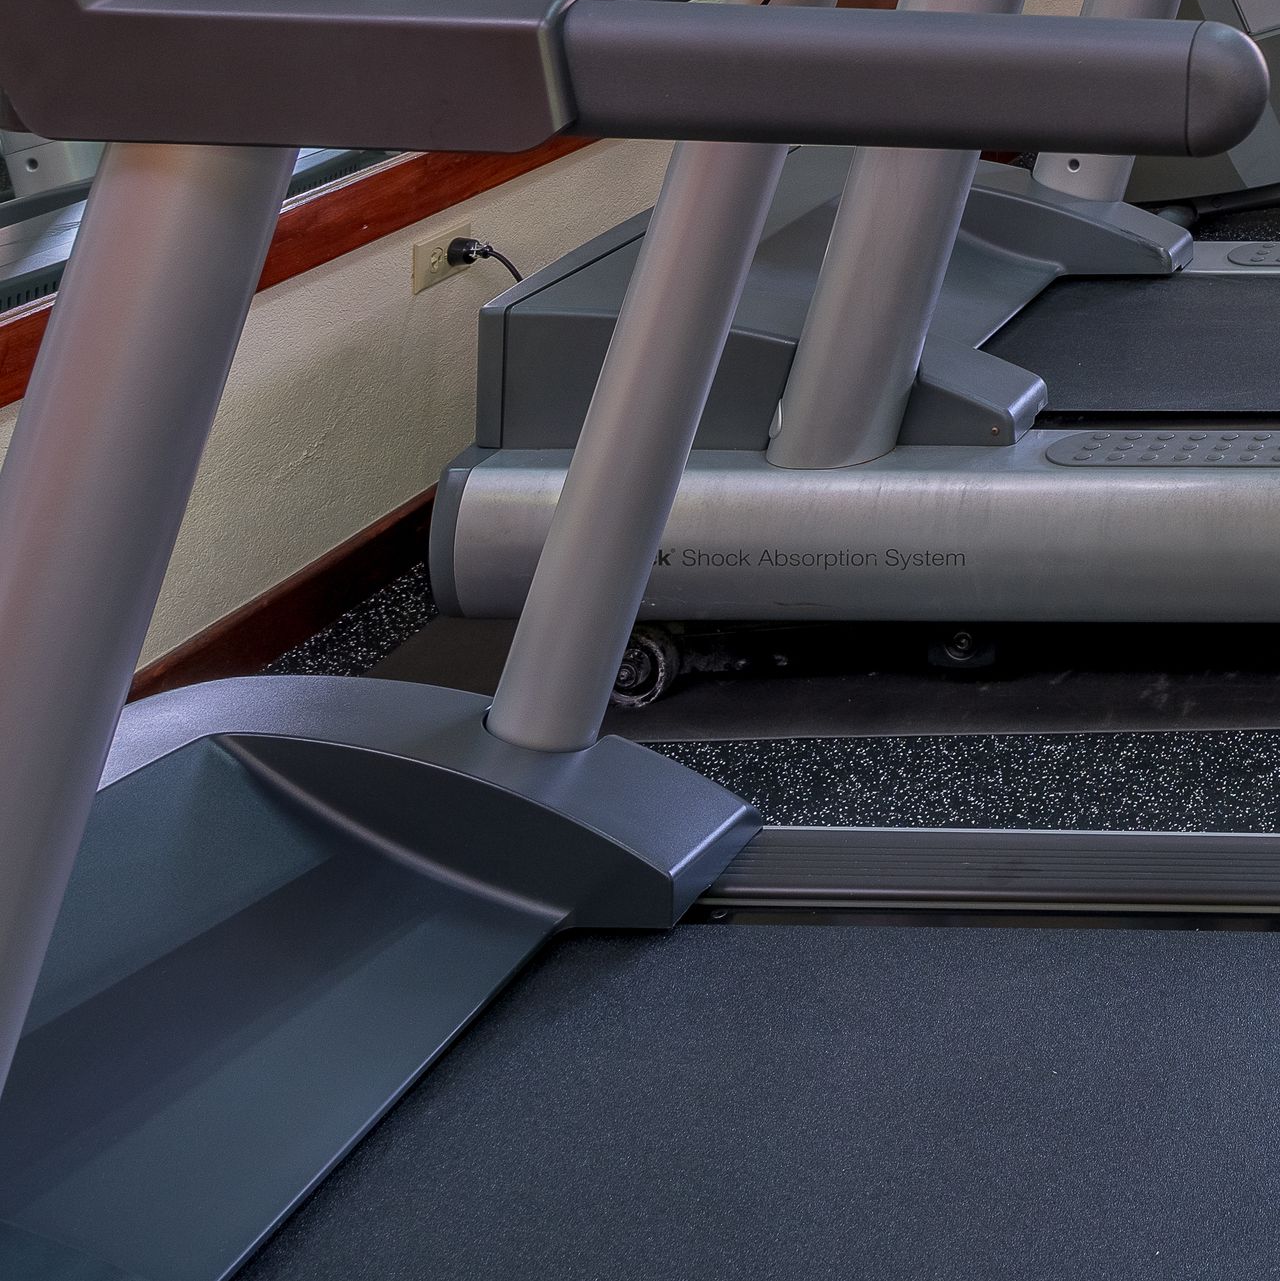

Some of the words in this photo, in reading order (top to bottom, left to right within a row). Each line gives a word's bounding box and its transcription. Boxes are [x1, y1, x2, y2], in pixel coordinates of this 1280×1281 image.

[682, 548, 751, 567] Shock
[758, 548, 878, 570] Absorption
[884, 548, 966, 570] System
